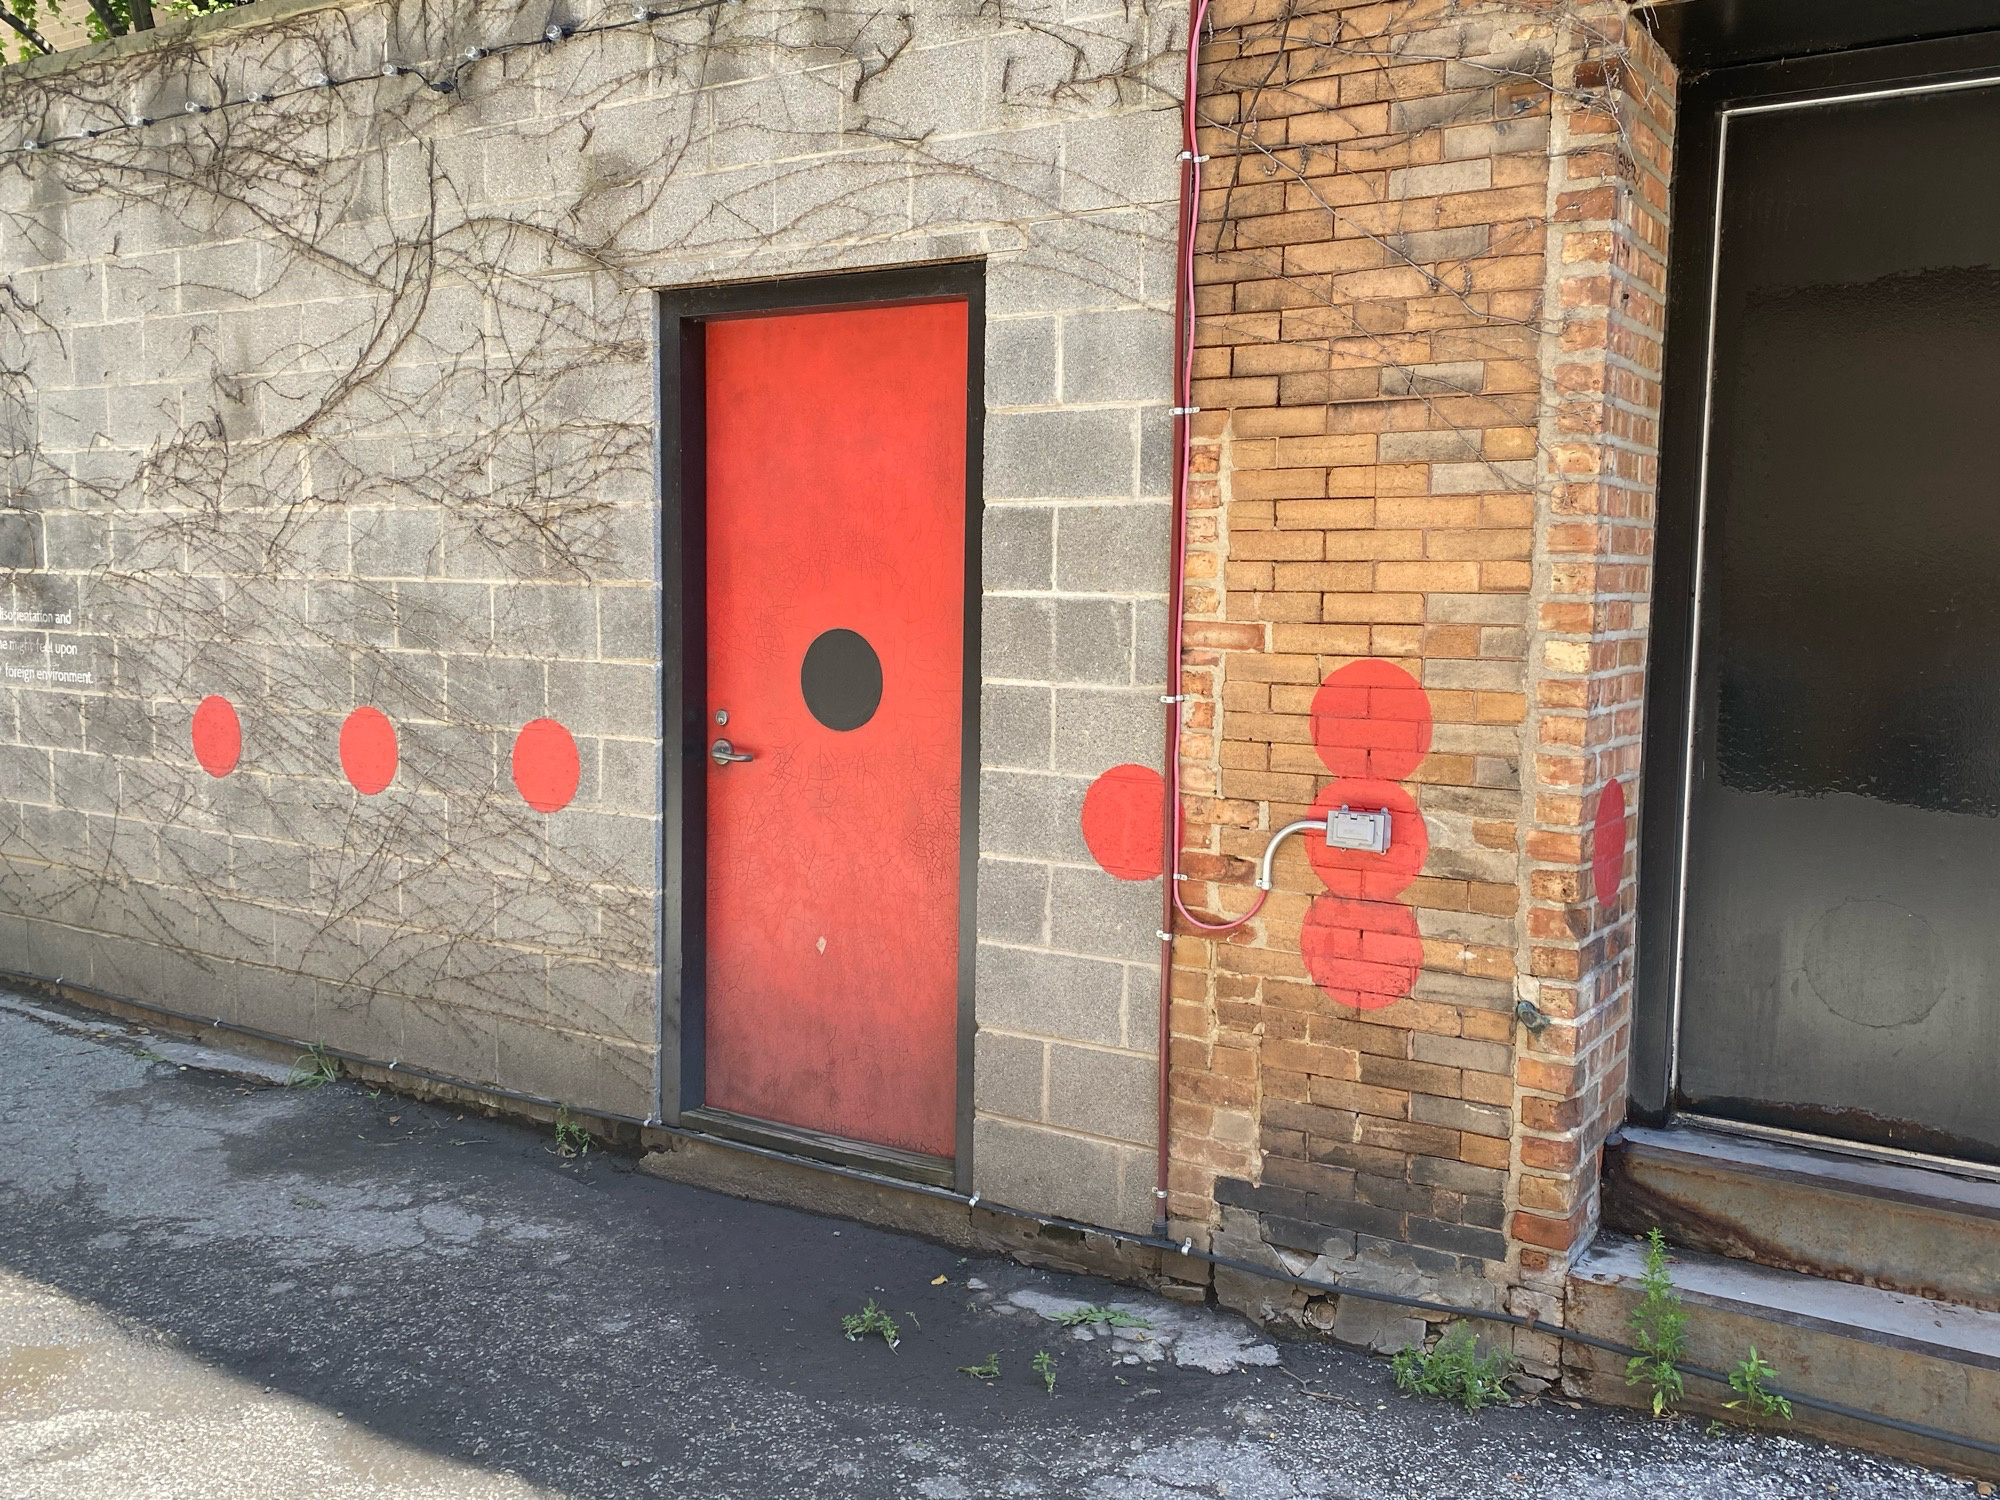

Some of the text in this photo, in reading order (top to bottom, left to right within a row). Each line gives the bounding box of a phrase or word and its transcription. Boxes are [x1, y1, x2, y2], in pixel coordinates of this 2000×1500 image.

[0, 607, 71, 624] isorientation and
[55, 643, 78, 657] upon
[5, 662, 34, 682] foreign
